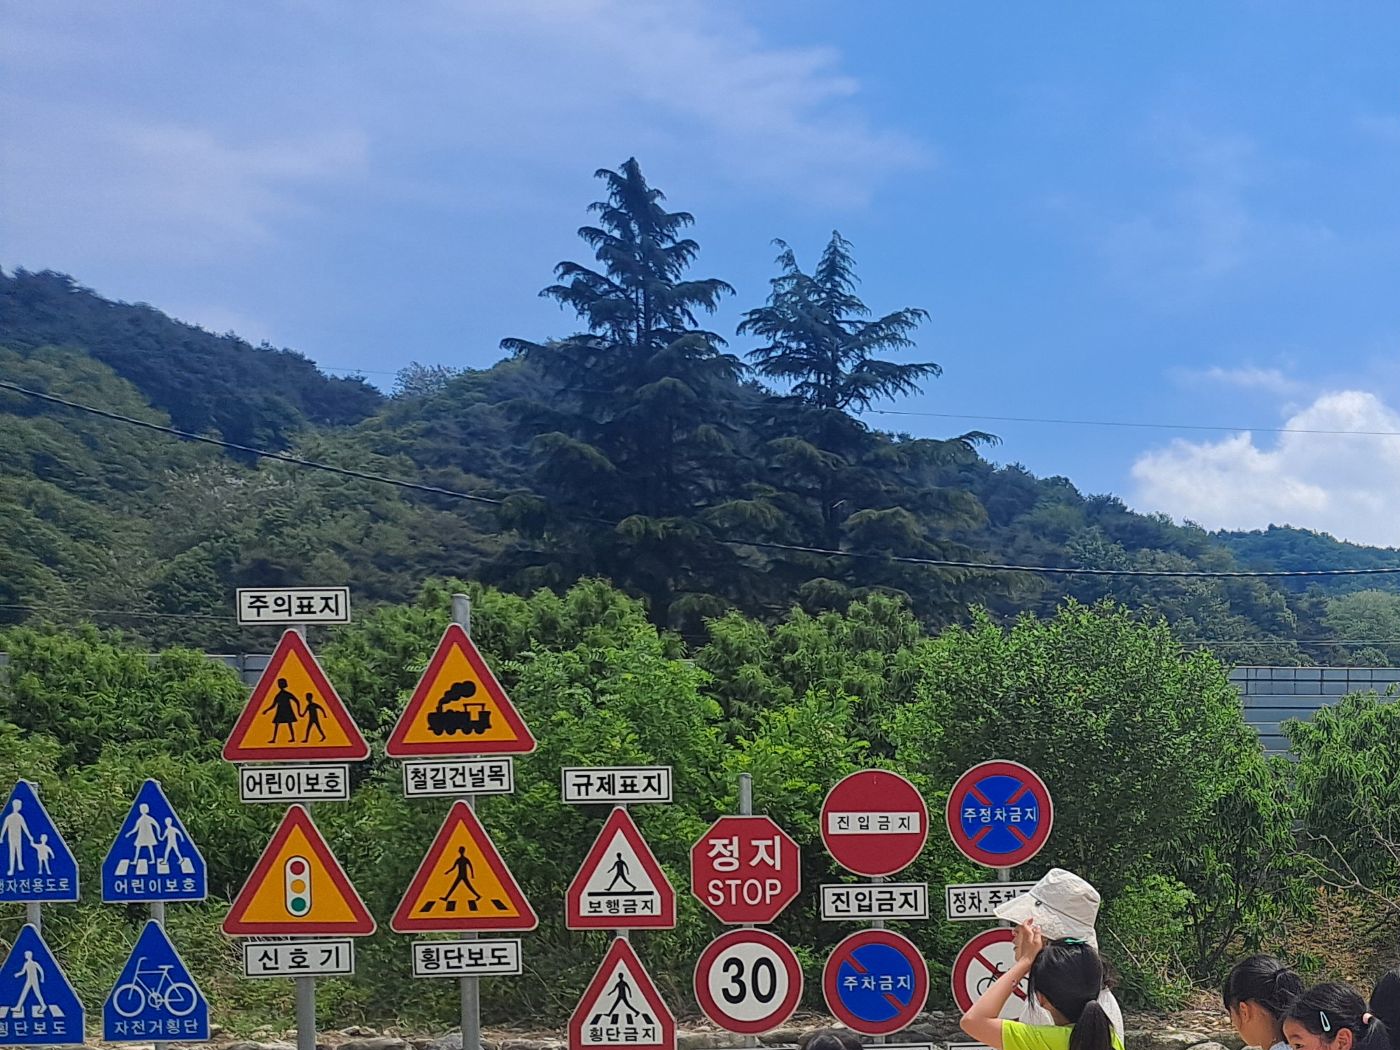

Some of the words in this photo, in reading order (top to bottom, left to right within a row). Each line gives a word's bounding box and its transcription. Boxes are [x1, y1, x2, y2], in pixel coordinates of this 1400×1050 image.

[247, 593, 340, 617] 주의표지
[246, 771, 342, 795] 어린이보호
[410, 765, 506, 789] 철길건널목
[572, 772, 662, 796] 규제표지
[837, 814, 911, 831] 진입금지
[963, 807, 1037, 823] 주정차금지
[707, 835, 782, 872] 정지
[114, 878, 197, 894] 어린이보호
[708, 879, 782, 906] STOP
[588, 898, 654, 914] 보행금지
[831, 889, 919, 913] 진입금지
[258, 946, 340, 971] 신호기
[420, 947, 511, 969] 횡단보도
[721, 956, 777, 1005] 30
[843, 974, 912, 991] 주차금지
[114, 1019, 199, 1036] 자전거횡단
[590, 1026, 655, 1042] 횡단금지
